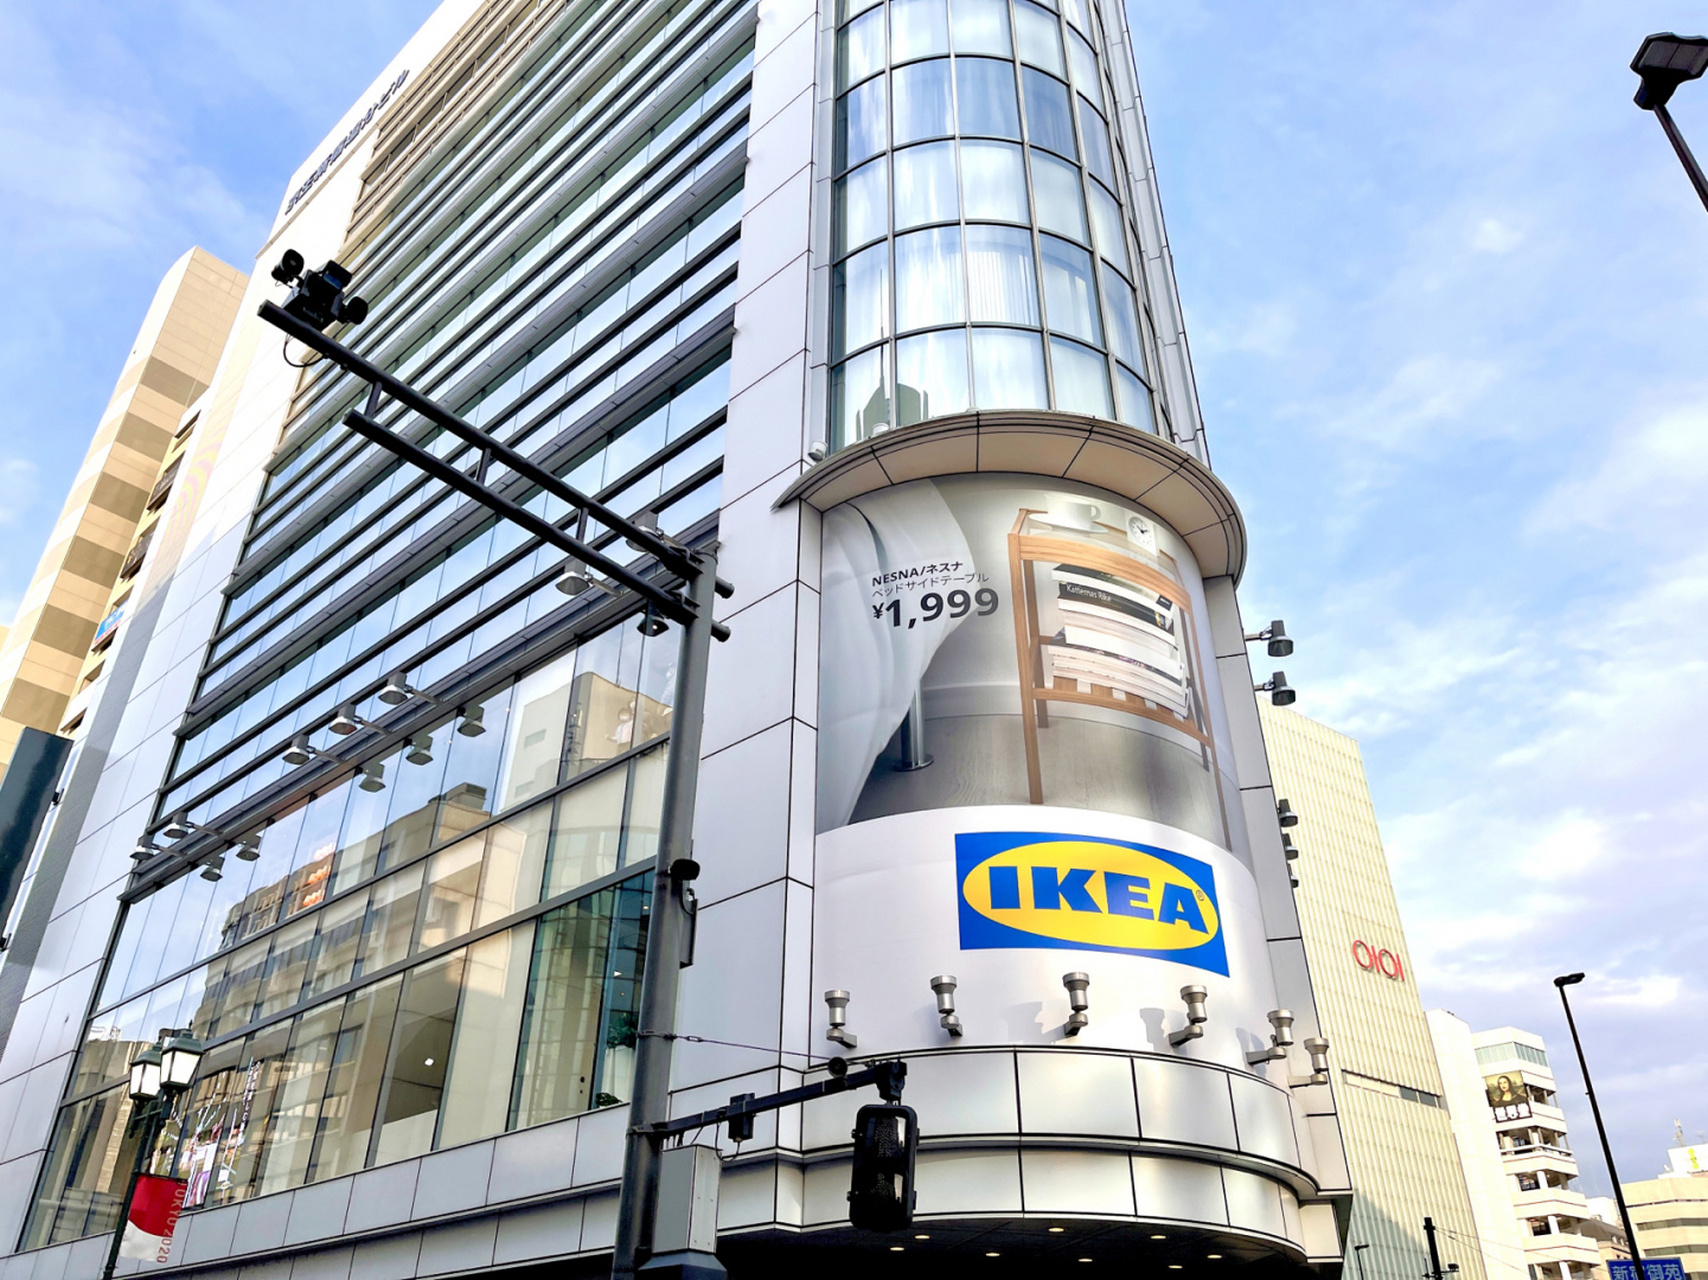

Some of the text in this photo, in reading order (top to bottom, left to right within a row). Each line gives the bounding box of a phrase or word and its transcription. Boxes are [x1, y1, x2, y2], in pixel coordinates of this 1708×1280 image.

[872, 587, 999, 629] ¥1,999
[989, 865, 1209, 935] IKEA
[156, 1180, 188, 1264] TOKYO 2020
